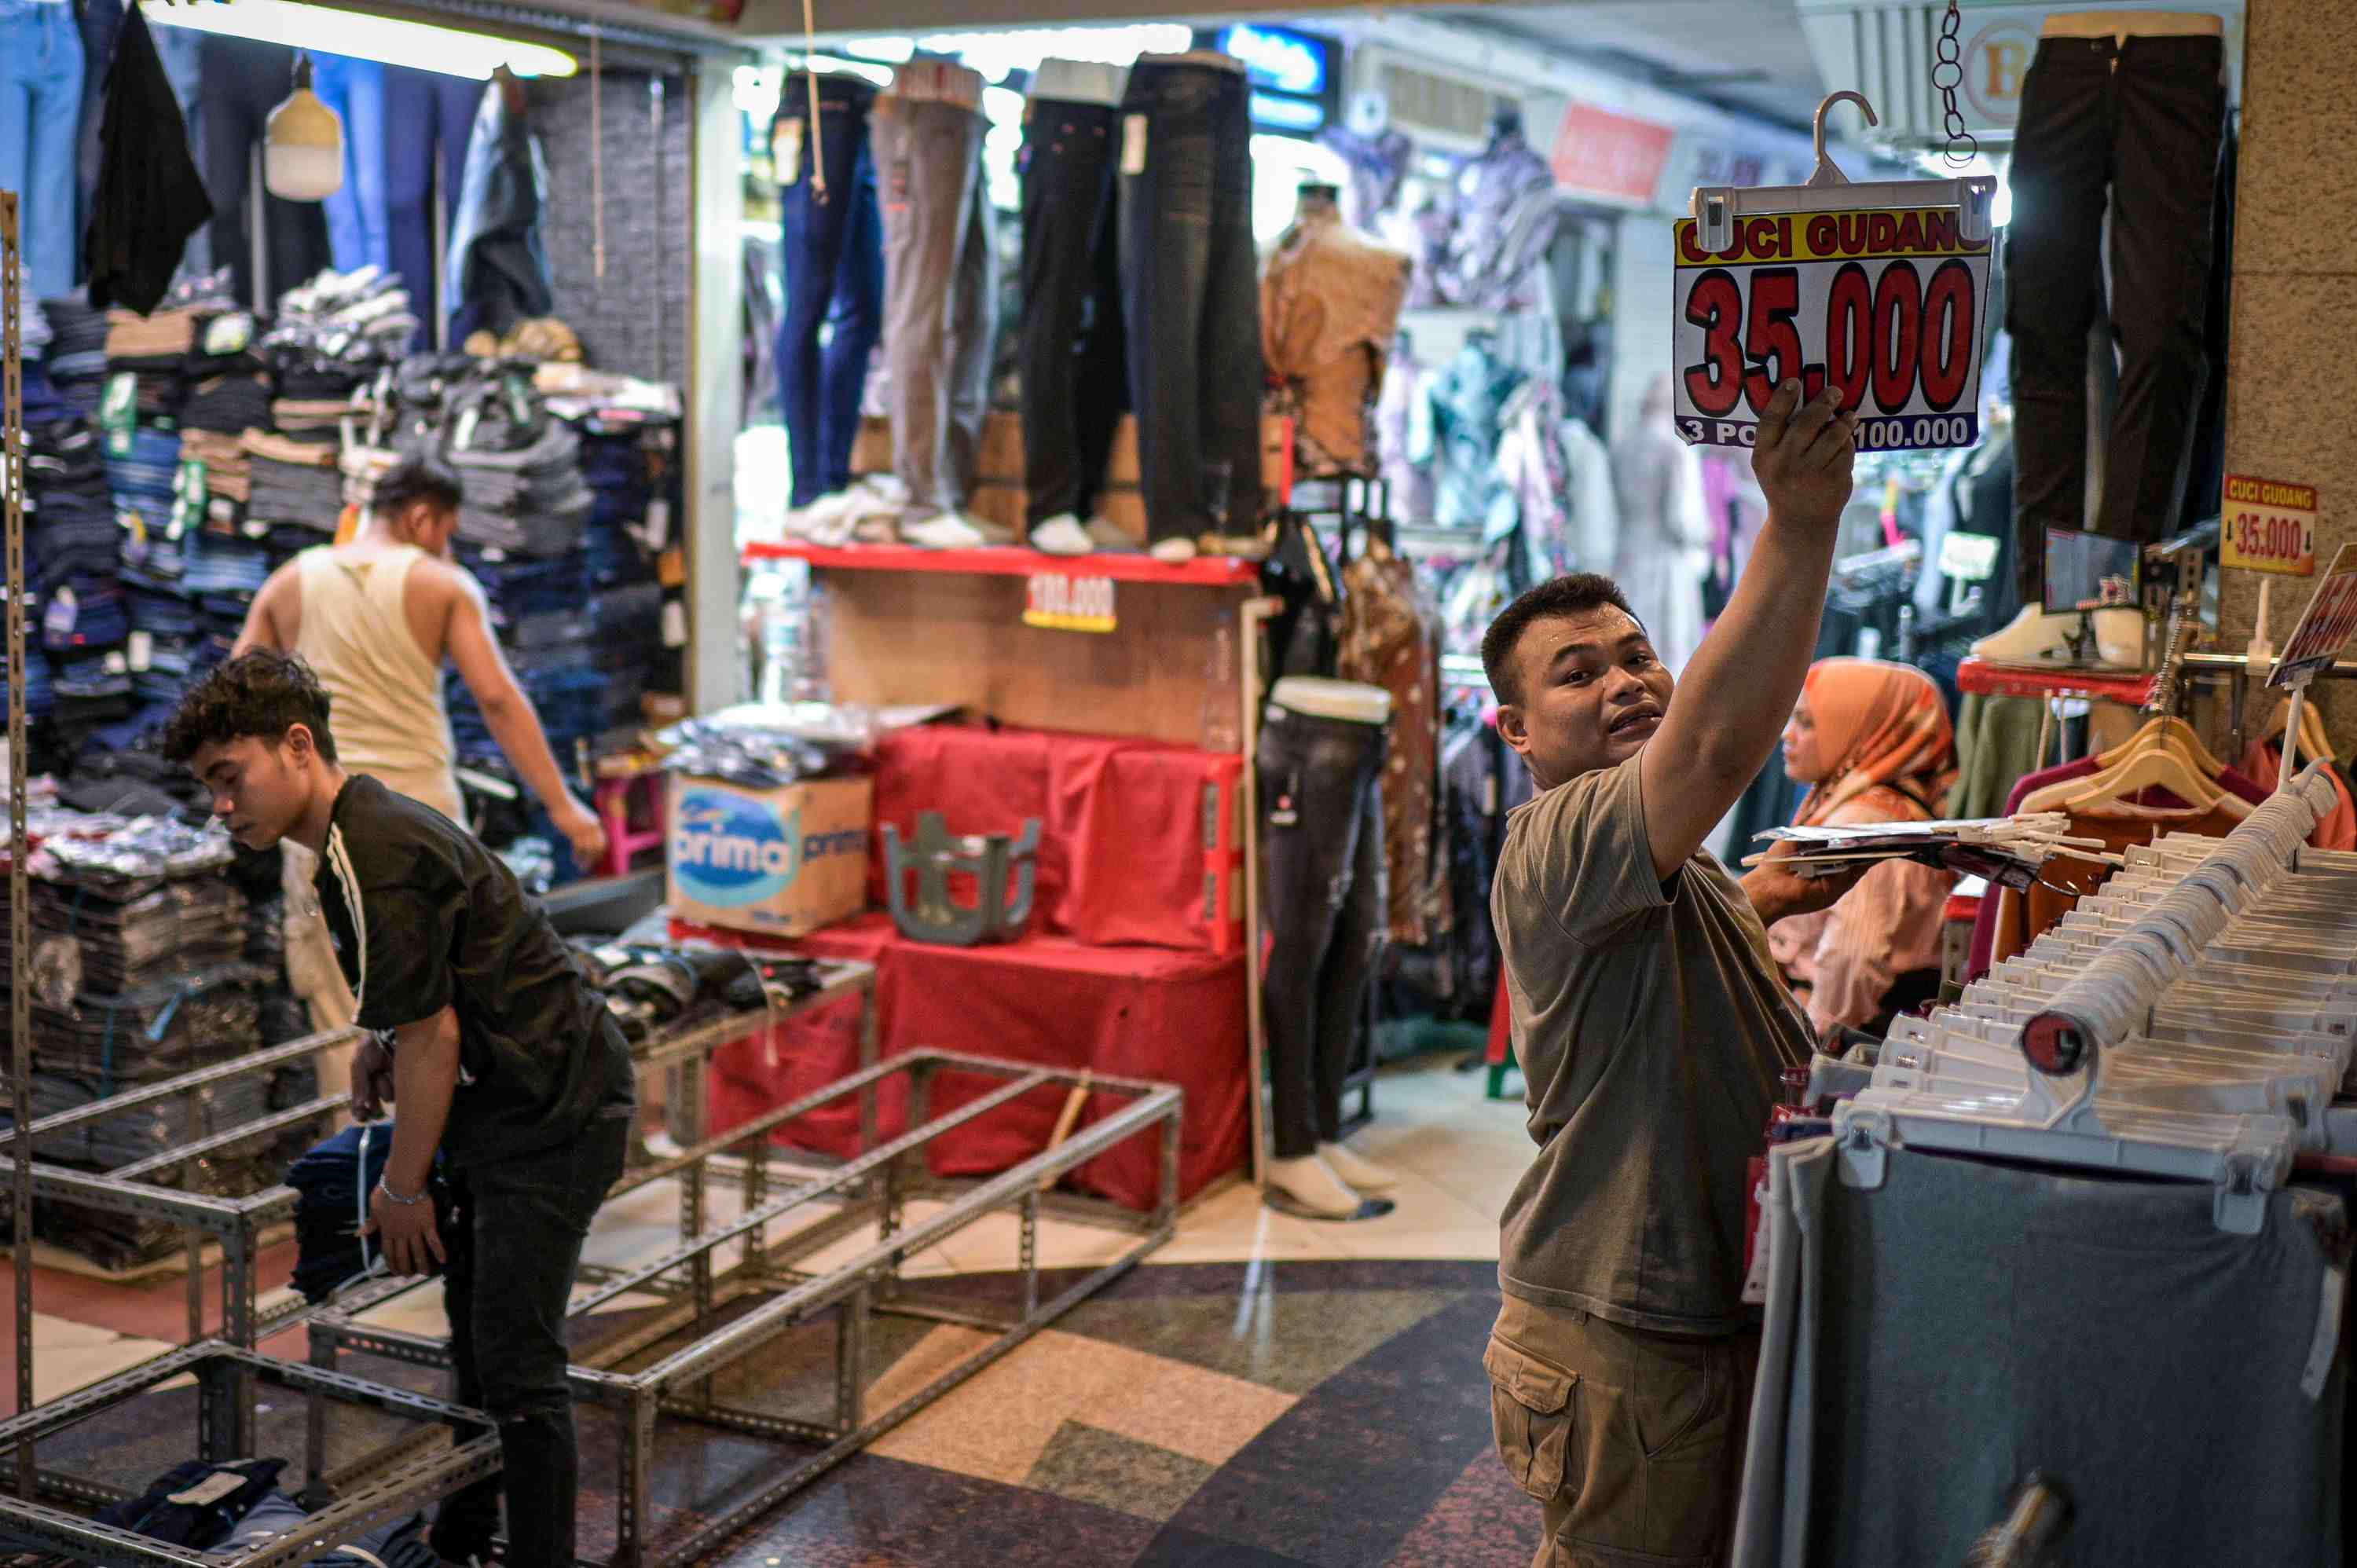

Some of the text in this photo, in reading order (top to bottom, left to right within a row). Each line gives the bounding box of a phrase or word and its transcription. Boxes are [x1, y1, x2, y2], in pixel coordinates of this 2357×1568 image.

[1806, 211, 1989, 255] GUDAN
[1684, 258, 1975, 418] 35.000
[1684, 417, 1968, 449] 3 PC 100.000
[2230, 480, 2312, 509] CUCI GUDANG
[2236, 512, 2301, 561] 35.000
